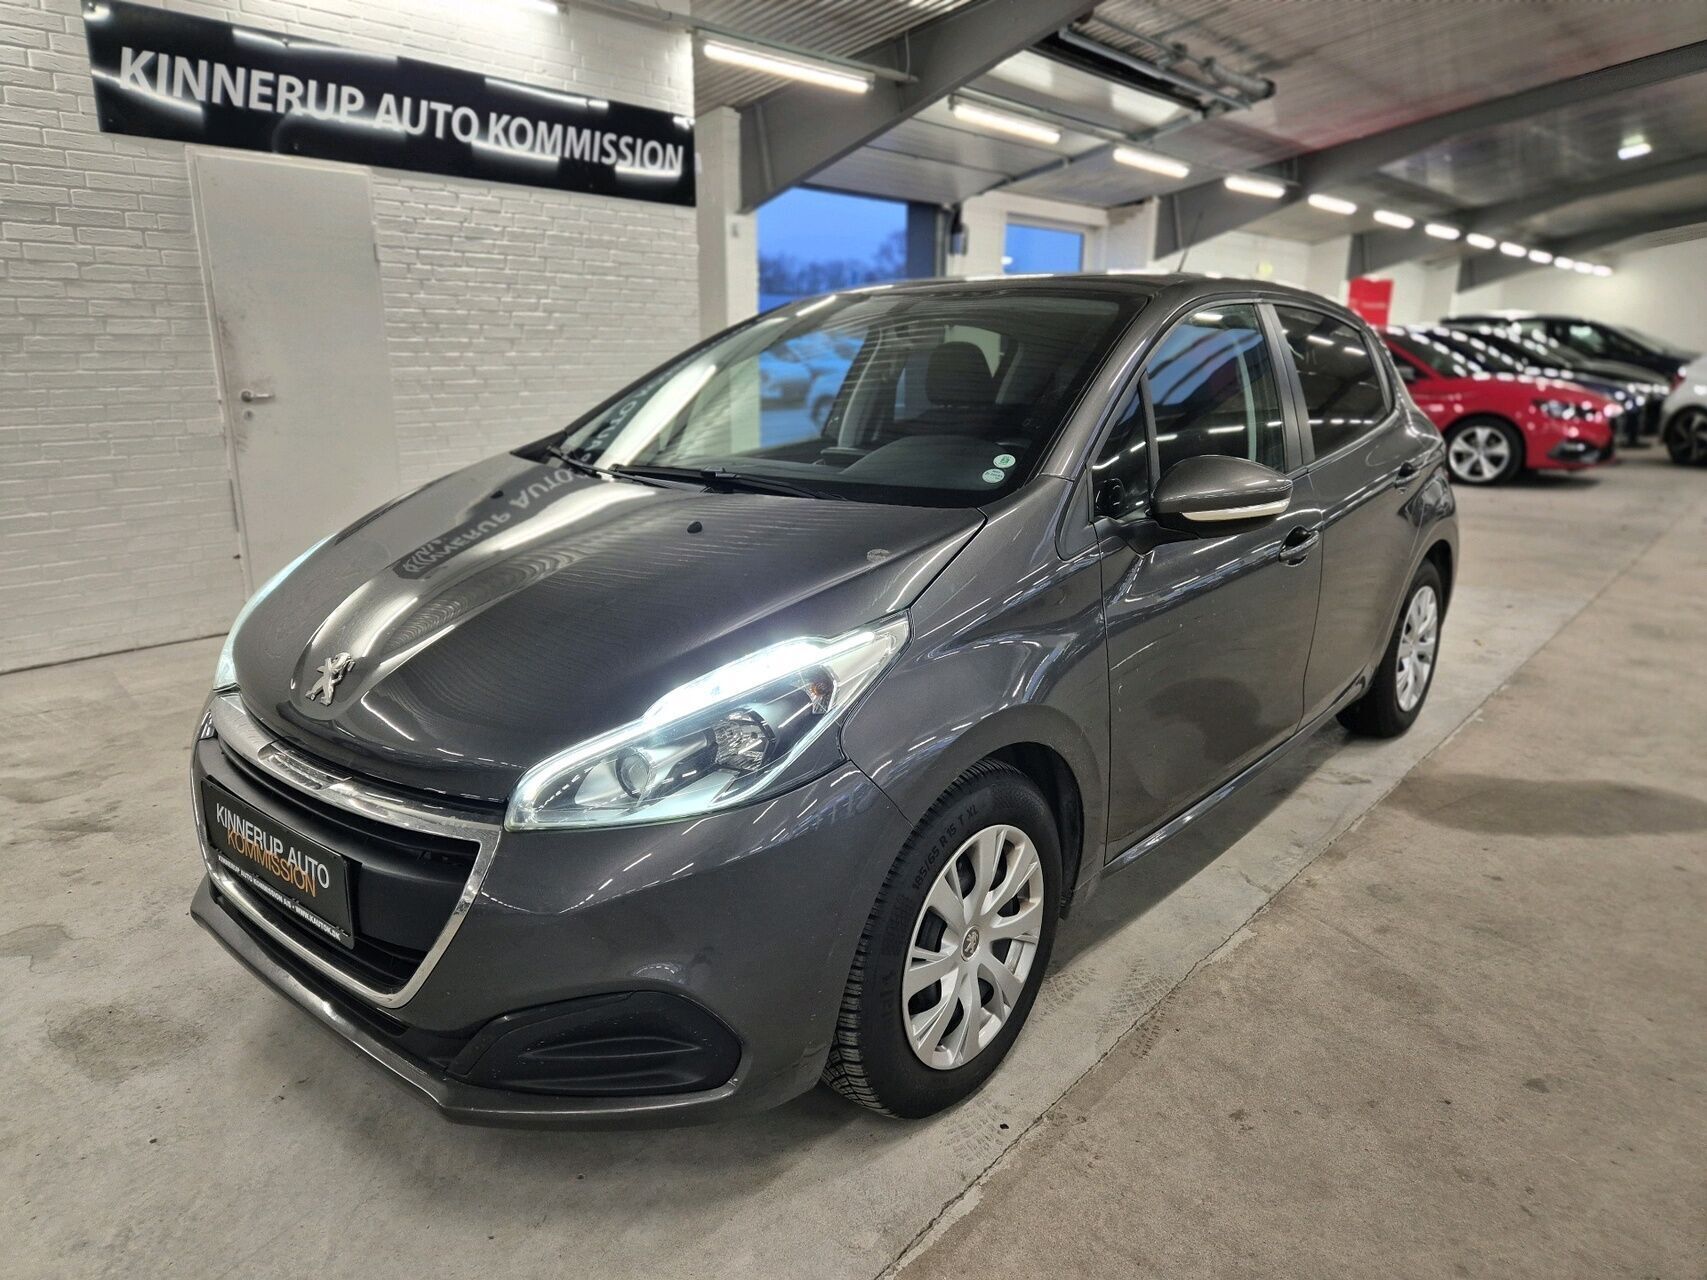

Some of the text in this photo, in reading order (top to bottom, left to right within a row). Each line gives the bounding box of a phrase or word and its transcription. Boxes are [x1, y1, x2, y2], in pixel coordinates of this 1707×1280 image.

[119, 46, 684, 173] KINNERUP AUTO KOMMISSION
[216, 803, 330, 889] KINNERUP AUTO
[227, 827, 316, 898] KOMMISSION
[240, 869, 253, 882] AUTO
[913, 846, 939, 890] 185/65
